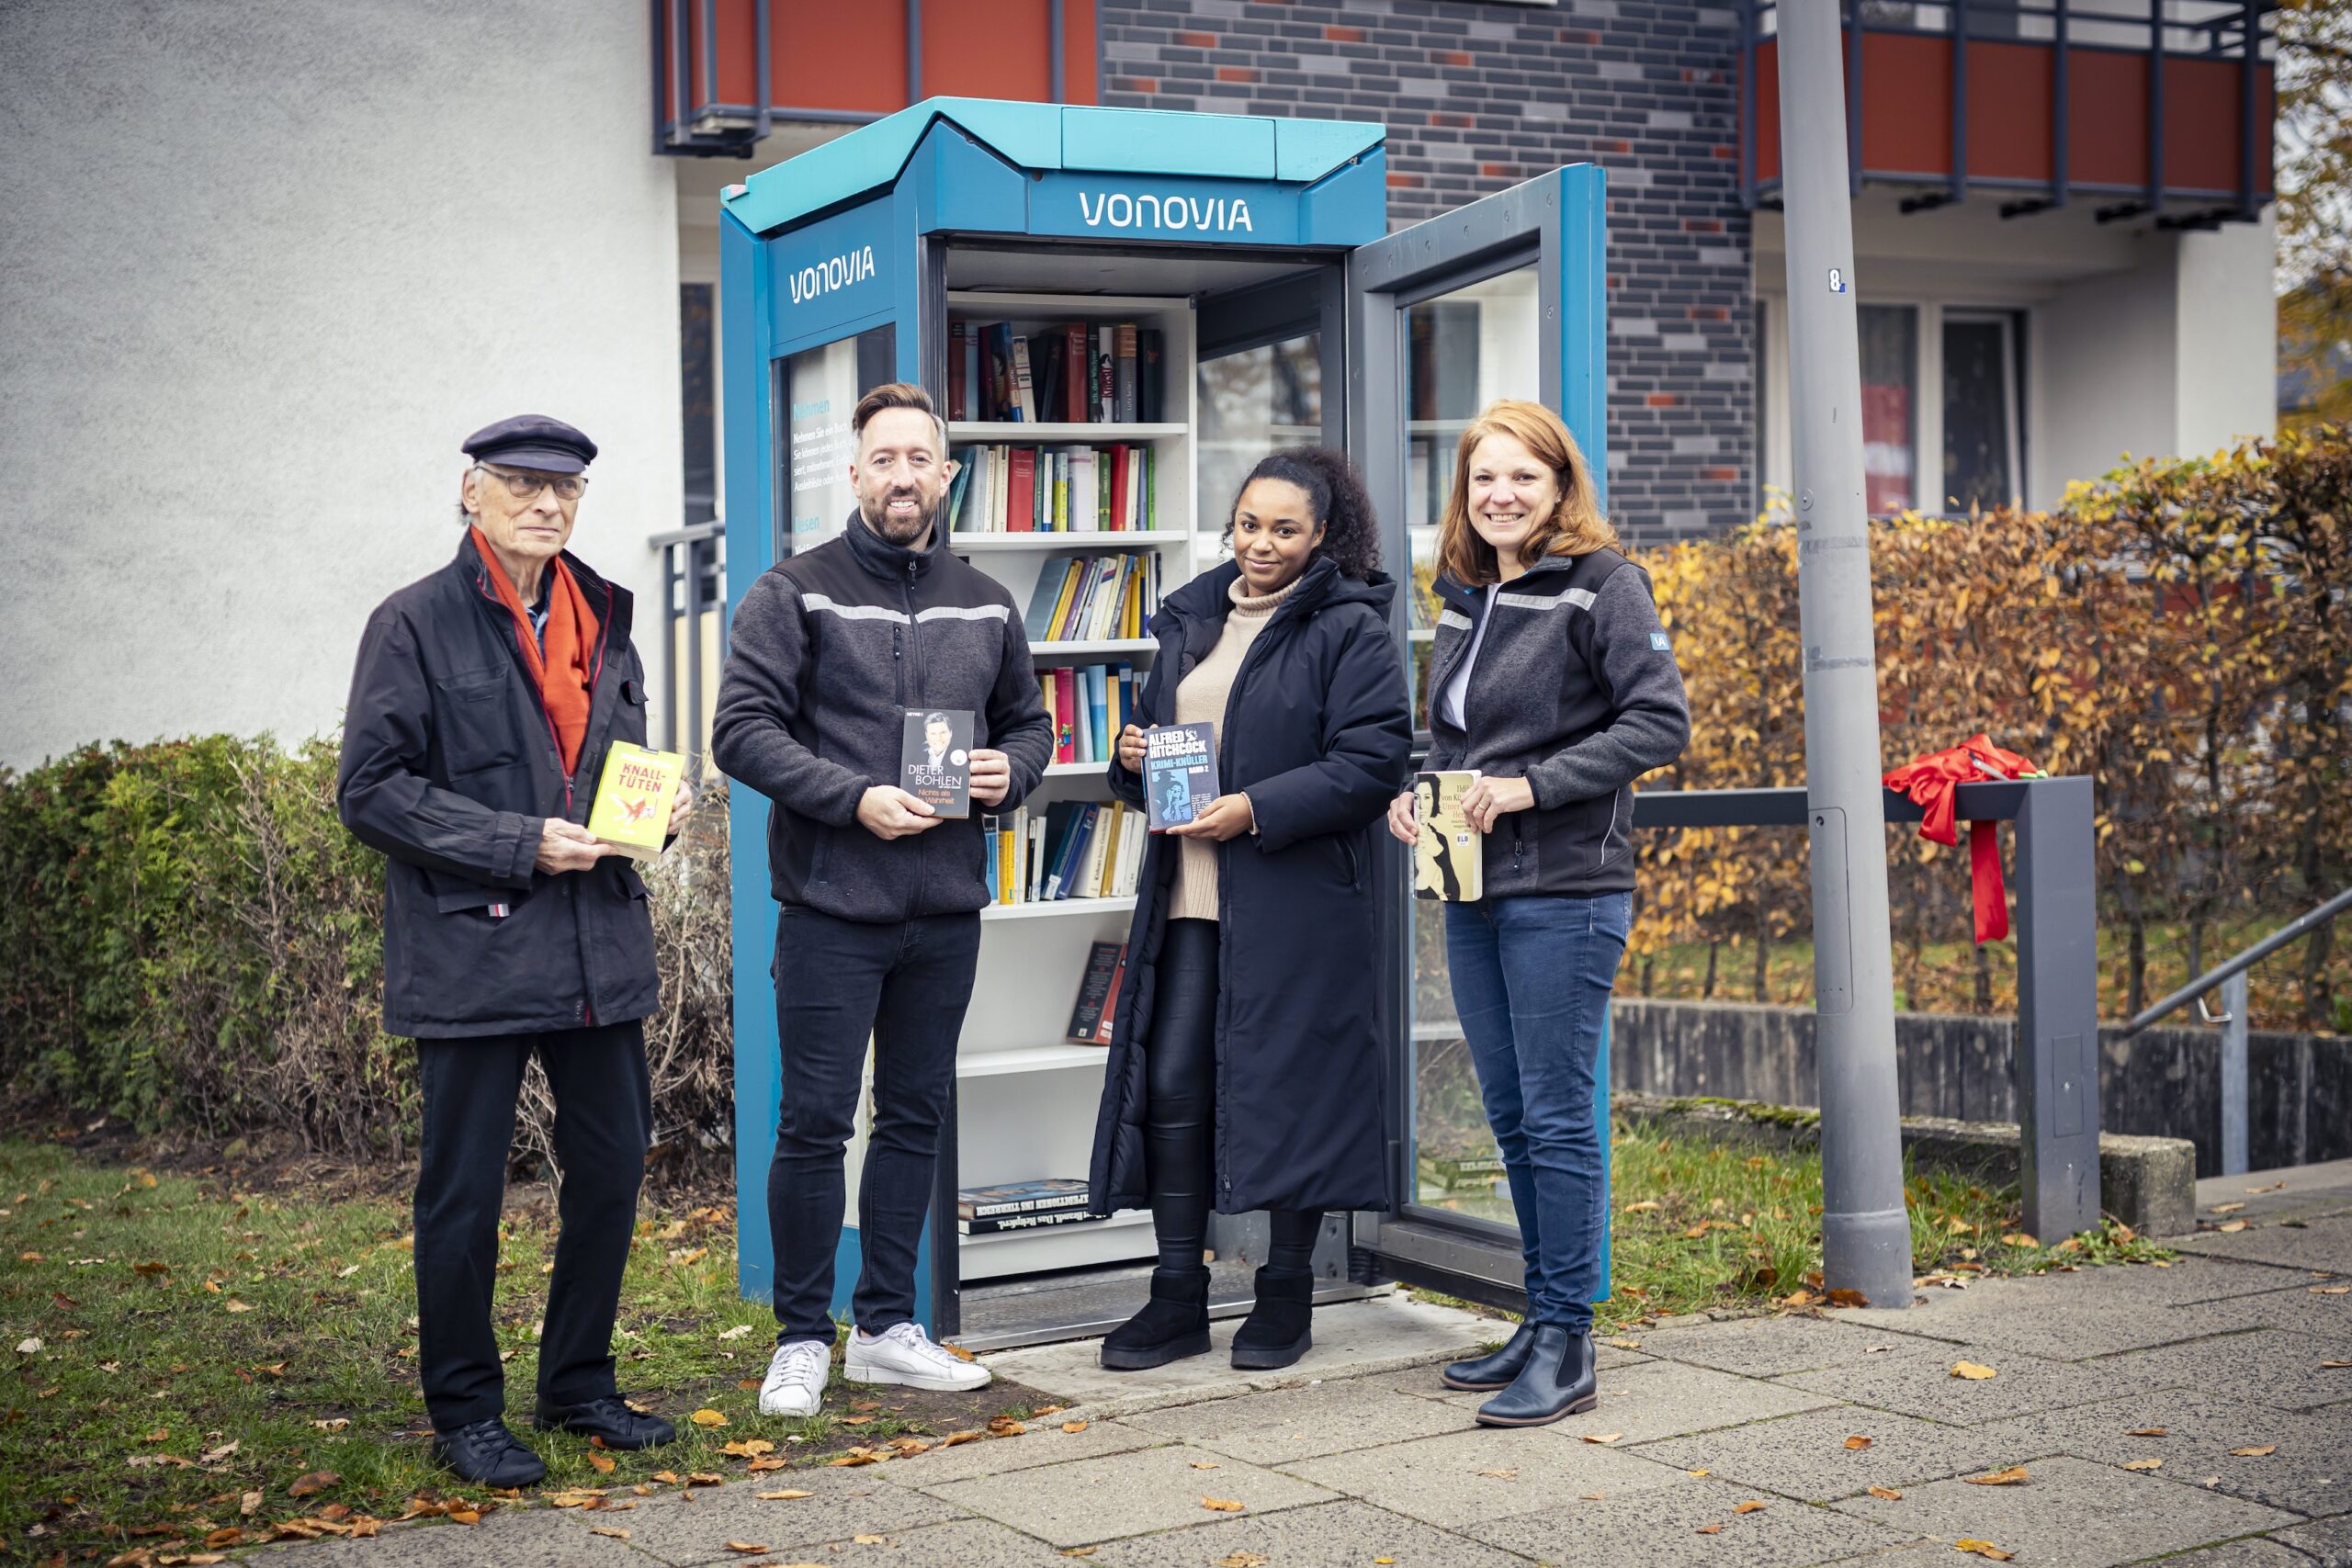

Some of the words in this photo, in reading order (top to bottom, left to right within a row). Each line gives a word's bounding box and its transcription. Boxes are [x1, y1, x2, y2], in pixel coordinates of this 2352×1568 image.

[1079, 192, 1253, 231] VONOVIA
[789, 244, 875, 304] VONOVIA
[794, 399, 830, 422] Nehmen
[794, 431, 815, 445] Nehmen
[816, 426, 824, 438] Sie
[825, 424, 833, 436] ein
[1148, 730, 1184, 747] ALFRED
[1149, 740, 1207, 759] HITCHCOCK
[908, 765, 944, 775] DIETER
[1150, 755, 1208, 771] KRIMI-KNÜLLER
[1188, 766, 1204, 774] BAND
[622, 763, 666, 780] KNALL-
[618, 774, 662, 793] TÜTEN
[915, 776, 962, 786] BOHLEN
[976, 1201, 1020, 1216] TIERREICH
[1020, 1200, 1035, 1212] INS
[1035, 1193, 1089, 1209] XPEDITIONEN
[1037, 1214, 1054, 1224] Das
